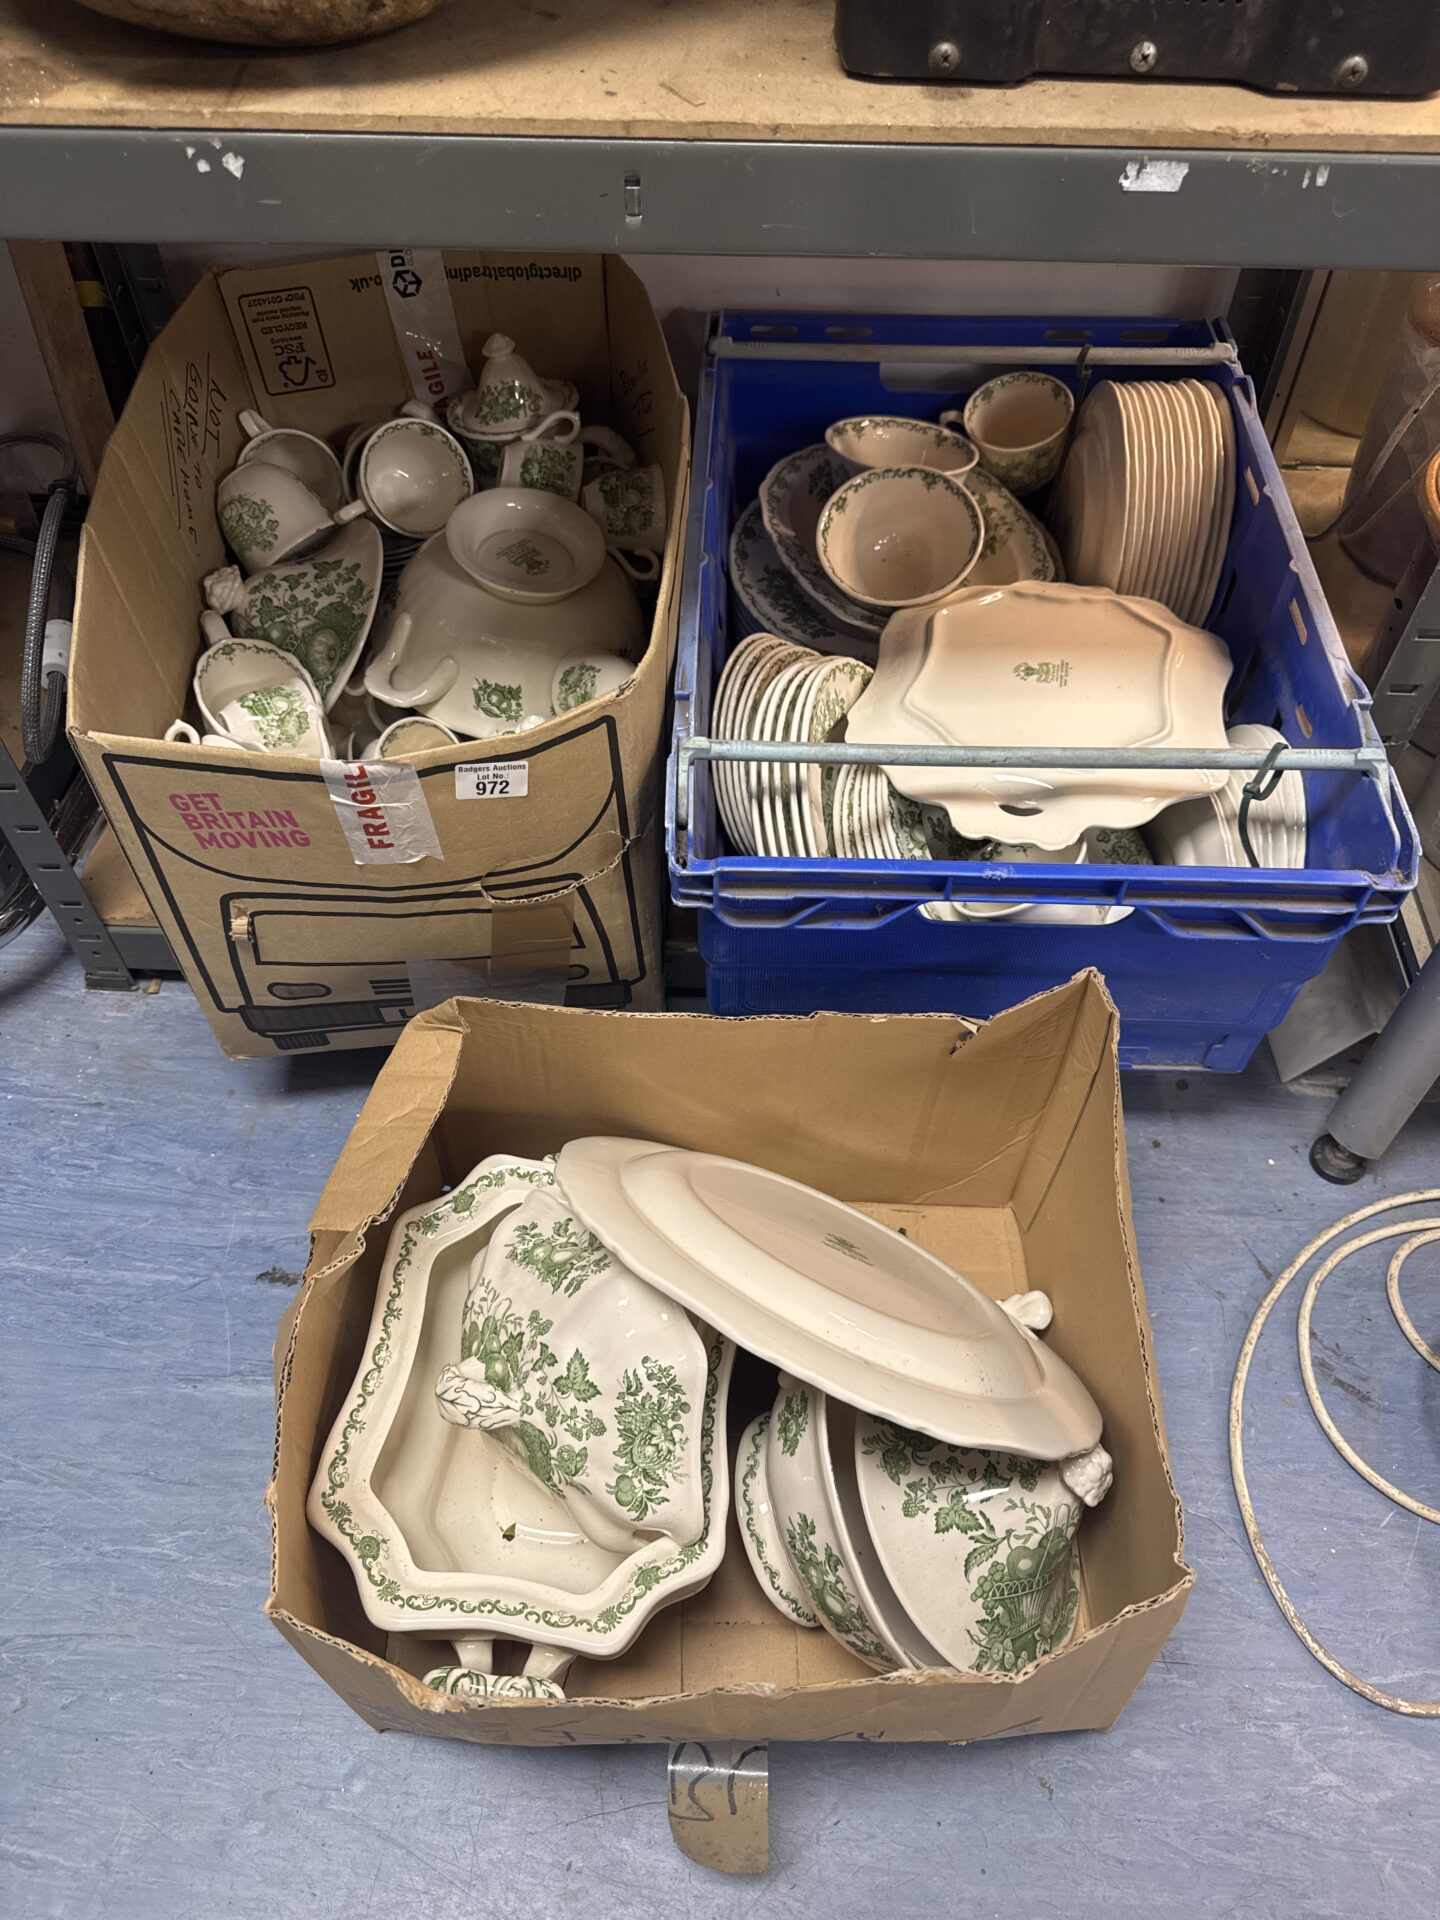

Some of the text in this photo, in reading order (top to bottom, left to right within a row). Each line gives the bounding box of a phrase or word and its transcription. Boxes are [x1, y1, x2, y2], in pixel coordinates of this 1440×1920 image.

[260, 321, 308, 335] RECYCLED
[272, 342, 306, 357] FSC
[205, 378, 228, 459] NOT
[458, 765, 490, 773] Badgers
[477, 773, 490, 781] Lot
[475, 780, 510, 796] 972
[169, 792, 223, 811] GET
[180, 809, 299, 830] BRITAIN
[193, 829, 311, 849] MOVING
